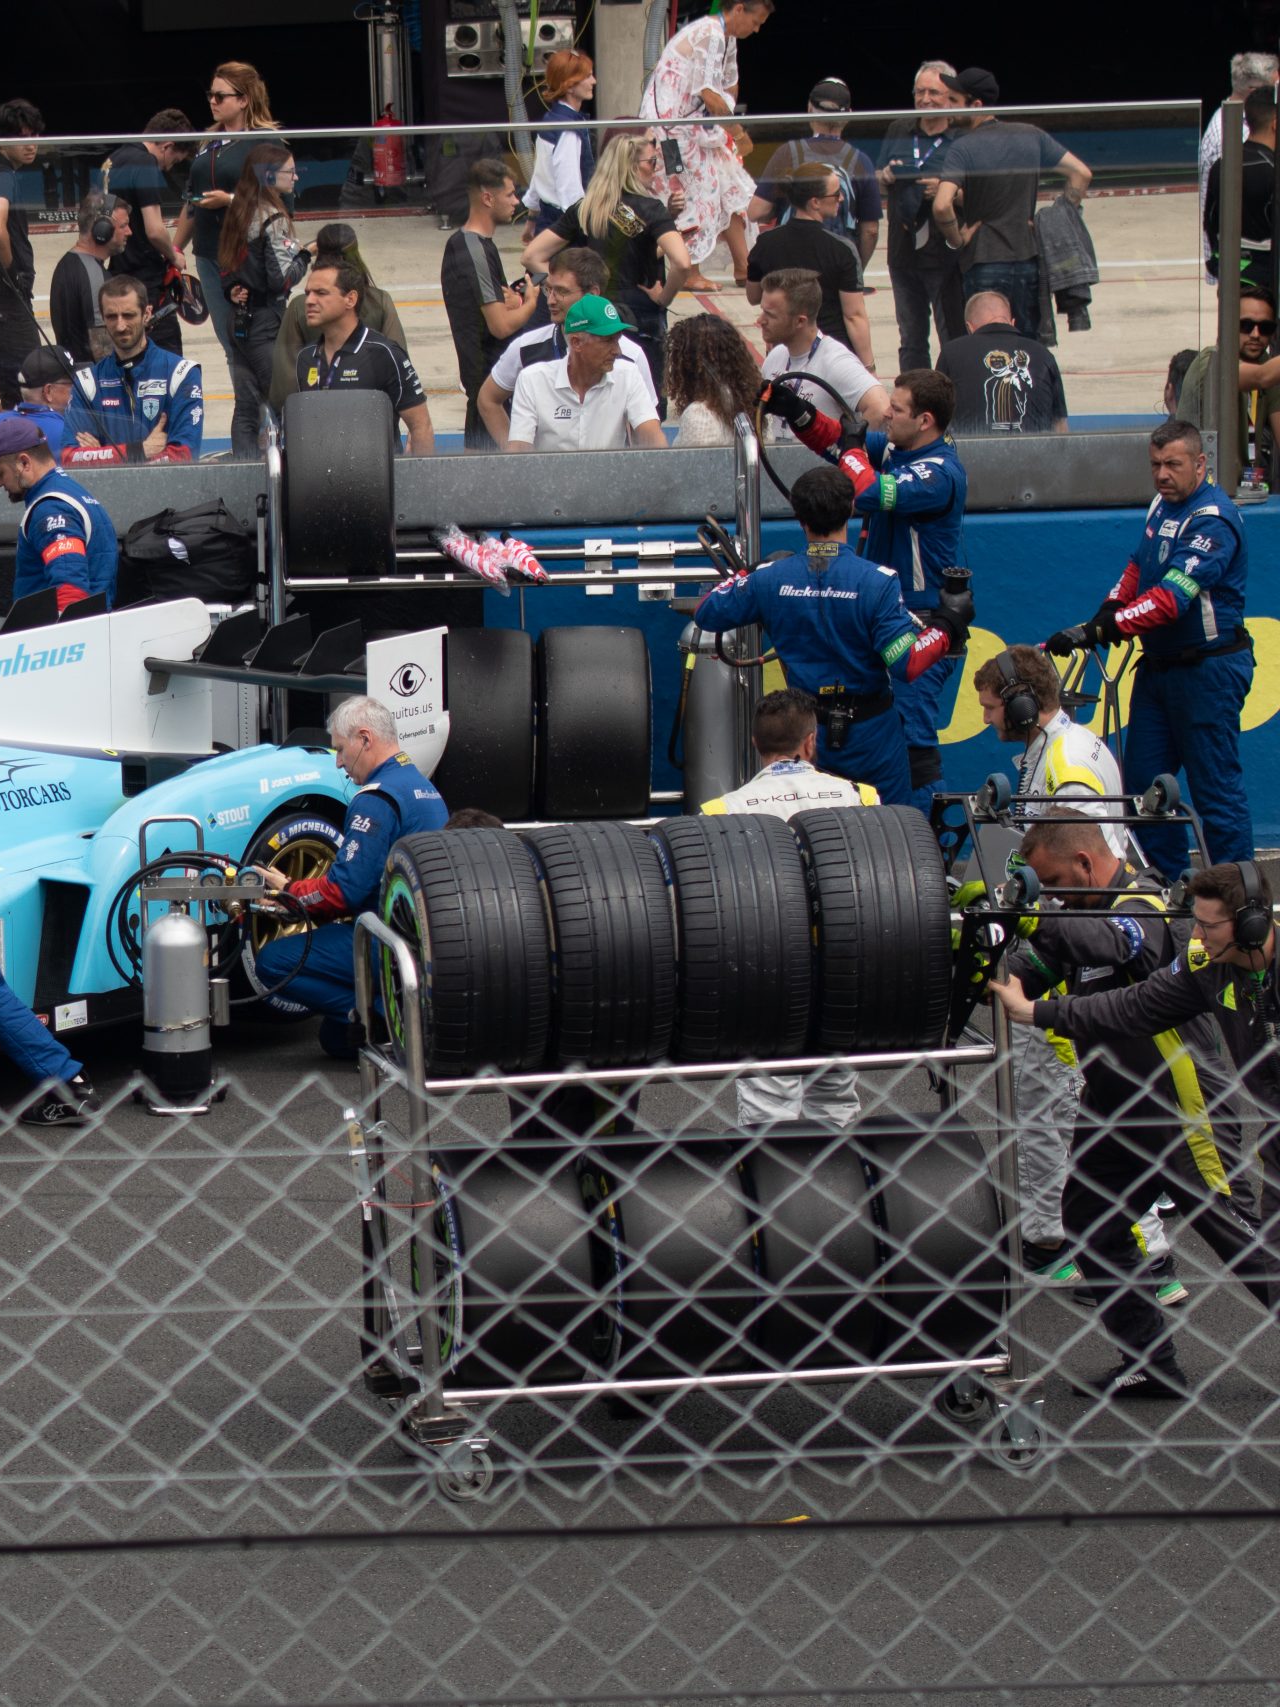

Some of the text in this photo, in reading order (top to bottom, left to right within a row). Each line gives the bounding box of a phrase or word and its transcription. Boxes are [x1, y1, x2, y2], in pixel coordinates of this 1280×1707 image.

[72, 448, 114, 462] MOTUL
[778, 584, 859, 600] Glickenhaus
[884, 630, 916, 664] PITLANE
[391, 703, 434, 721] uitus.us
[745, 789, 845, 807] BYKOLLES
[216, 805, 252, 827] STOUT
[287, 820, 338, 840] MICHELIN
[1121, 917, 1140, 939] TYRE
